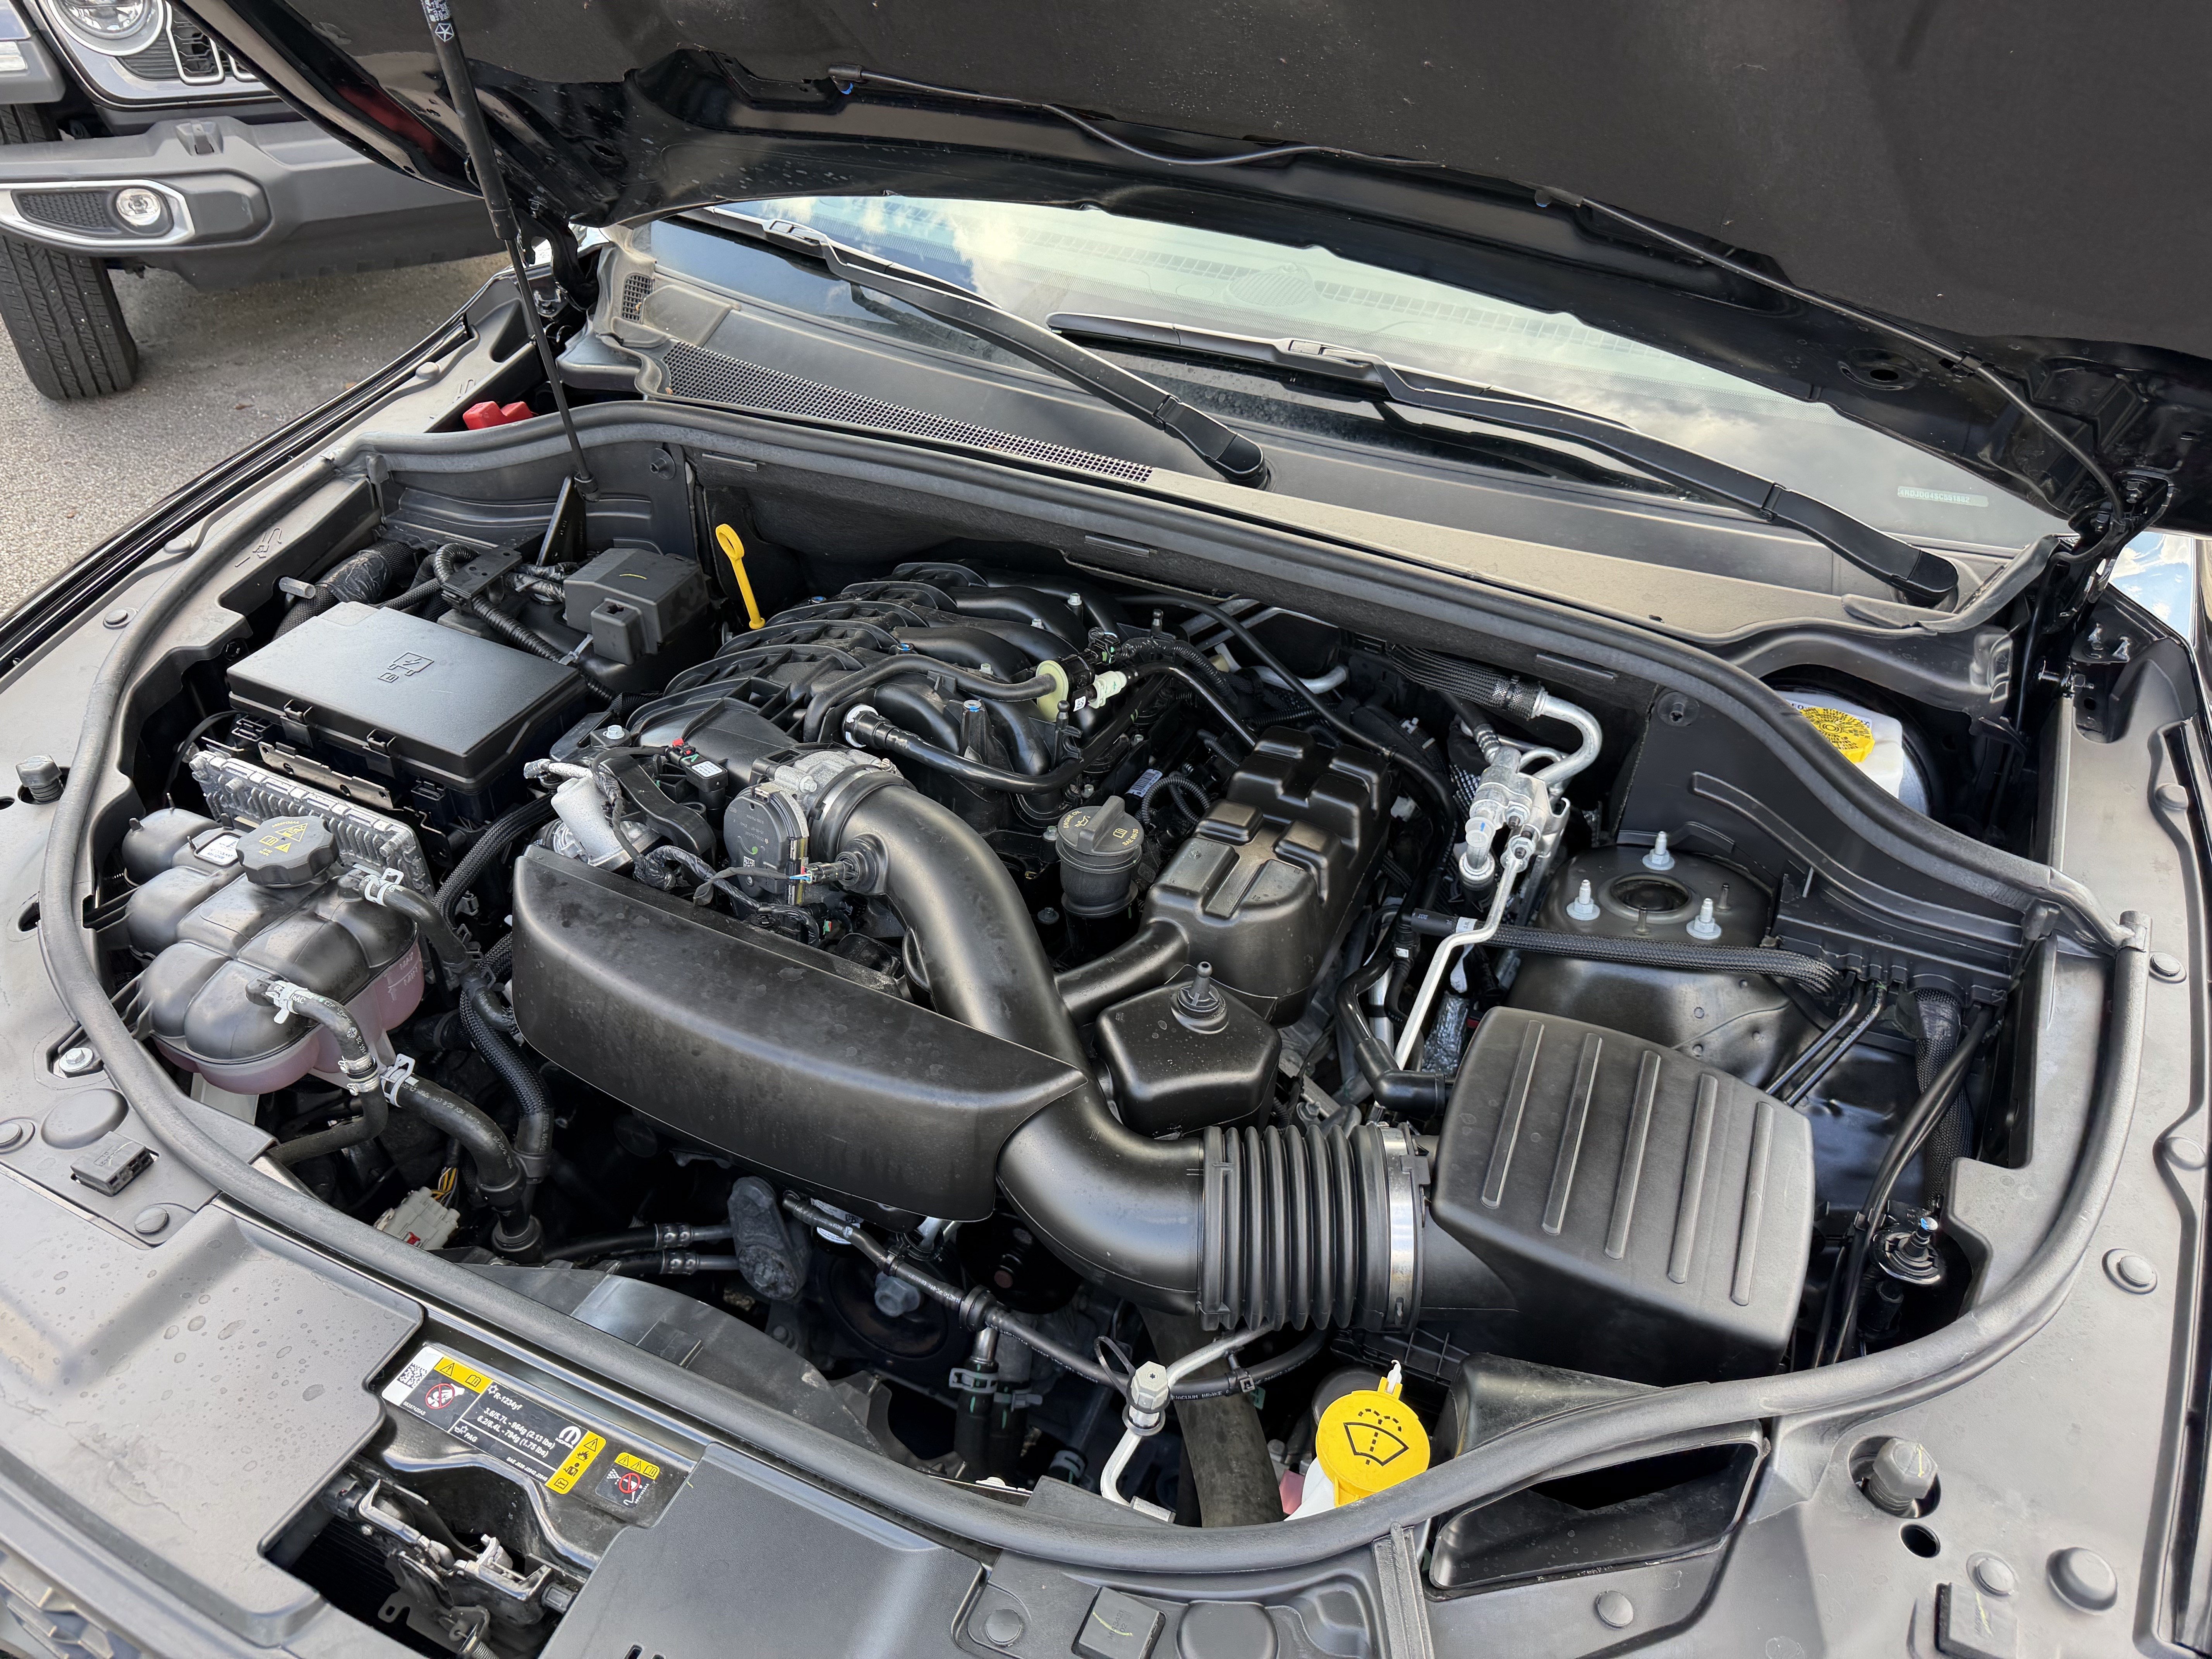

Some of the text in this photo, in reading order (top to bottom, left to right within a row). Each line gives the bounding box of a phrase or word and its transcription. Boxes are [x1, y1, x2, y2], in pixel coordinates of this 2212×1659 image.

[1063, 815, 1073, 828] ENGINE
[493, 1392, 523, 1410] R-1234yf
[464, 1432, 478, 1443] PAG
[477, 1415, 500, 1432] 6.2/6.4L
[504, 1429, 520, 1443] 794g
[519, 1438, 537, 1451] (1.75
[535, 1445, 549, 1458] lbs)
[484, 1407, 508, 1424] 3.6/5.7L
[511, 1422, 527, 1435] 964g
[526, 1430, 543, 1443] (2.13
[542, 1438, 555, 1450] lbs)
